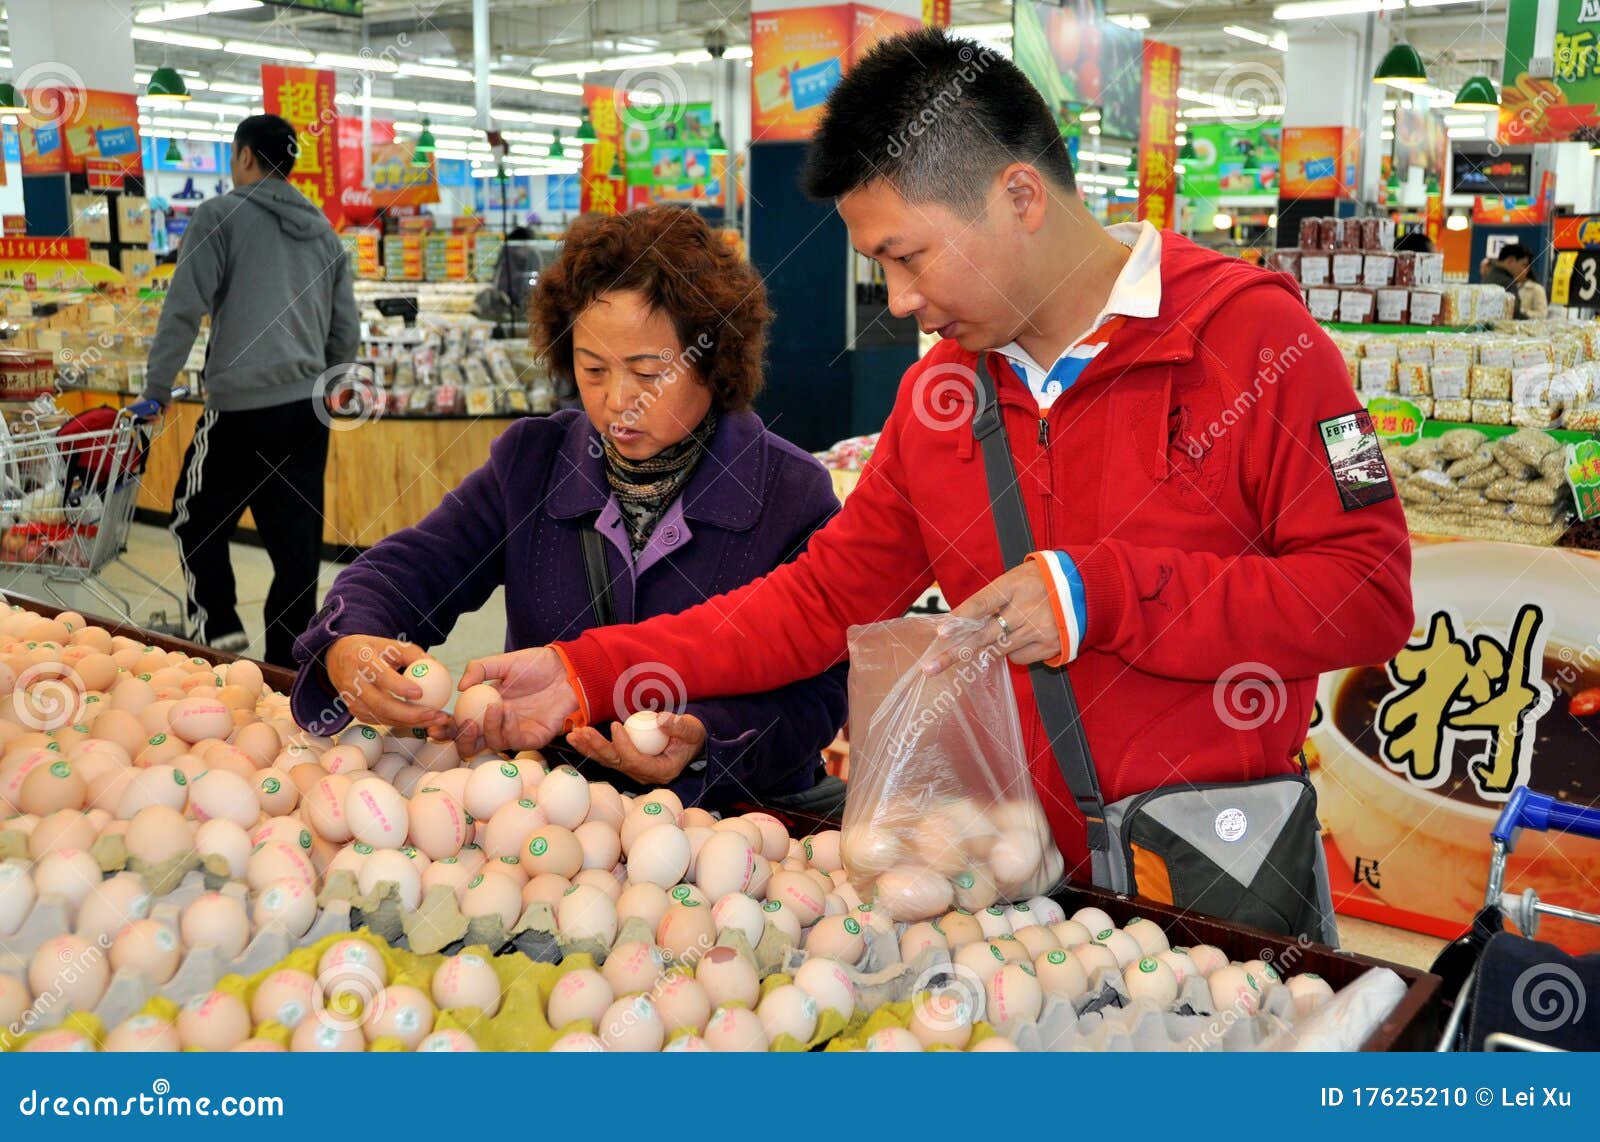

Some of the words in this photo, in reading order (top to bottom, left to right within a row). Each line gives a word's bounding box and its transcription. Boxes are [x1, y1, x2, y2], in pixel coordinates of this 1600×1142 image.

[1554, 32, 1600, 78] 新
[1578, 257, 1597, 301] 3
[1325, 415, 1371, 438] Ferrari
[1353, 855, 1381, 889] 民
